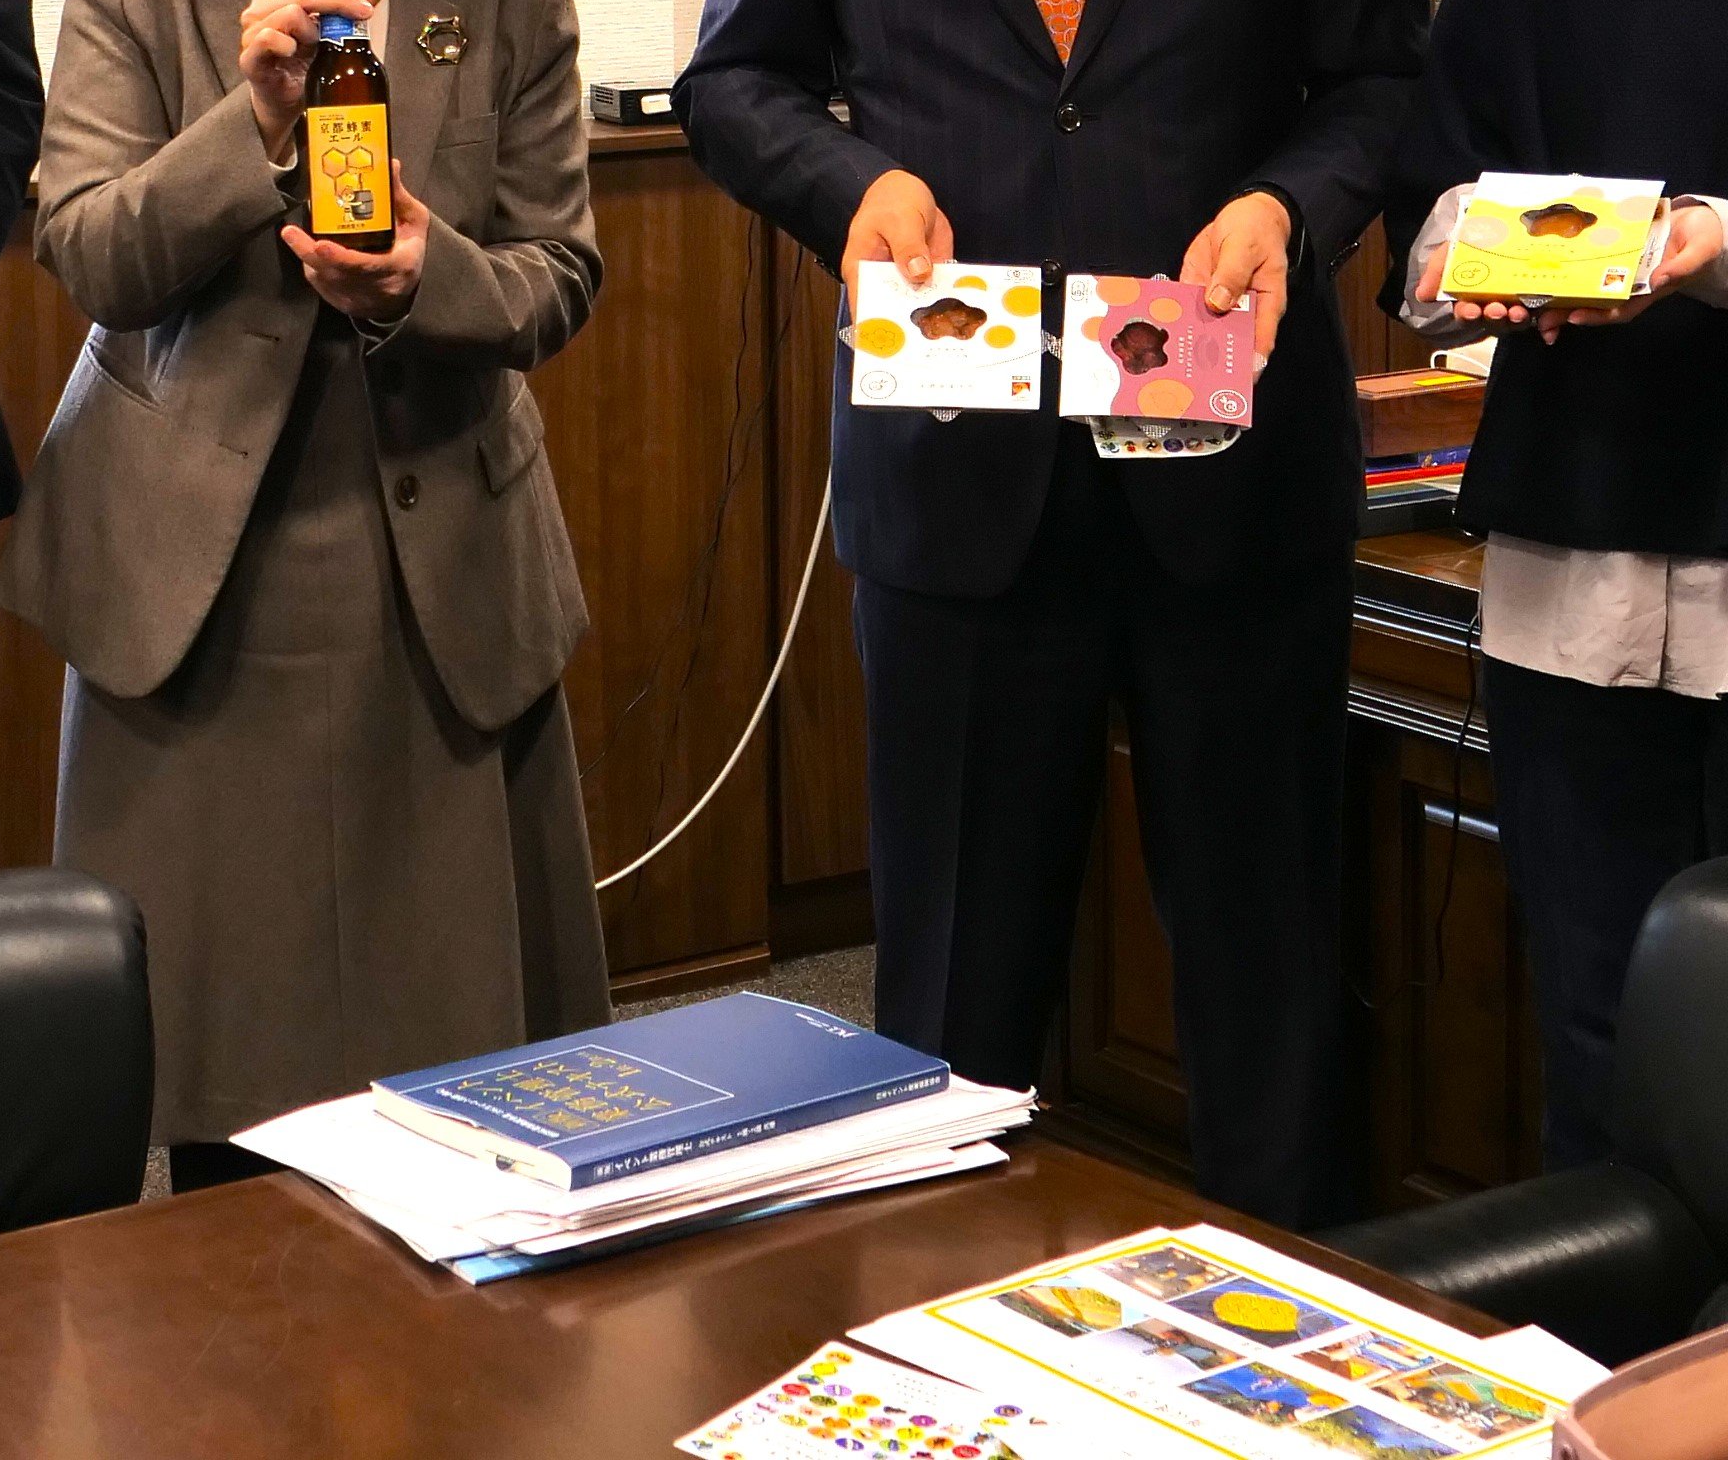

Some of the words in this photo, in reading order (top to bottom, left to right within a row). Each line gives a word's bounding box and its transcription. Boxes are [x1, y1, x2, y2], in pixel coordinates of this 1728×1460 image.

[320, 120, 372, 134] 京都蜂蜜
[329, 132, 364, 143] エール
